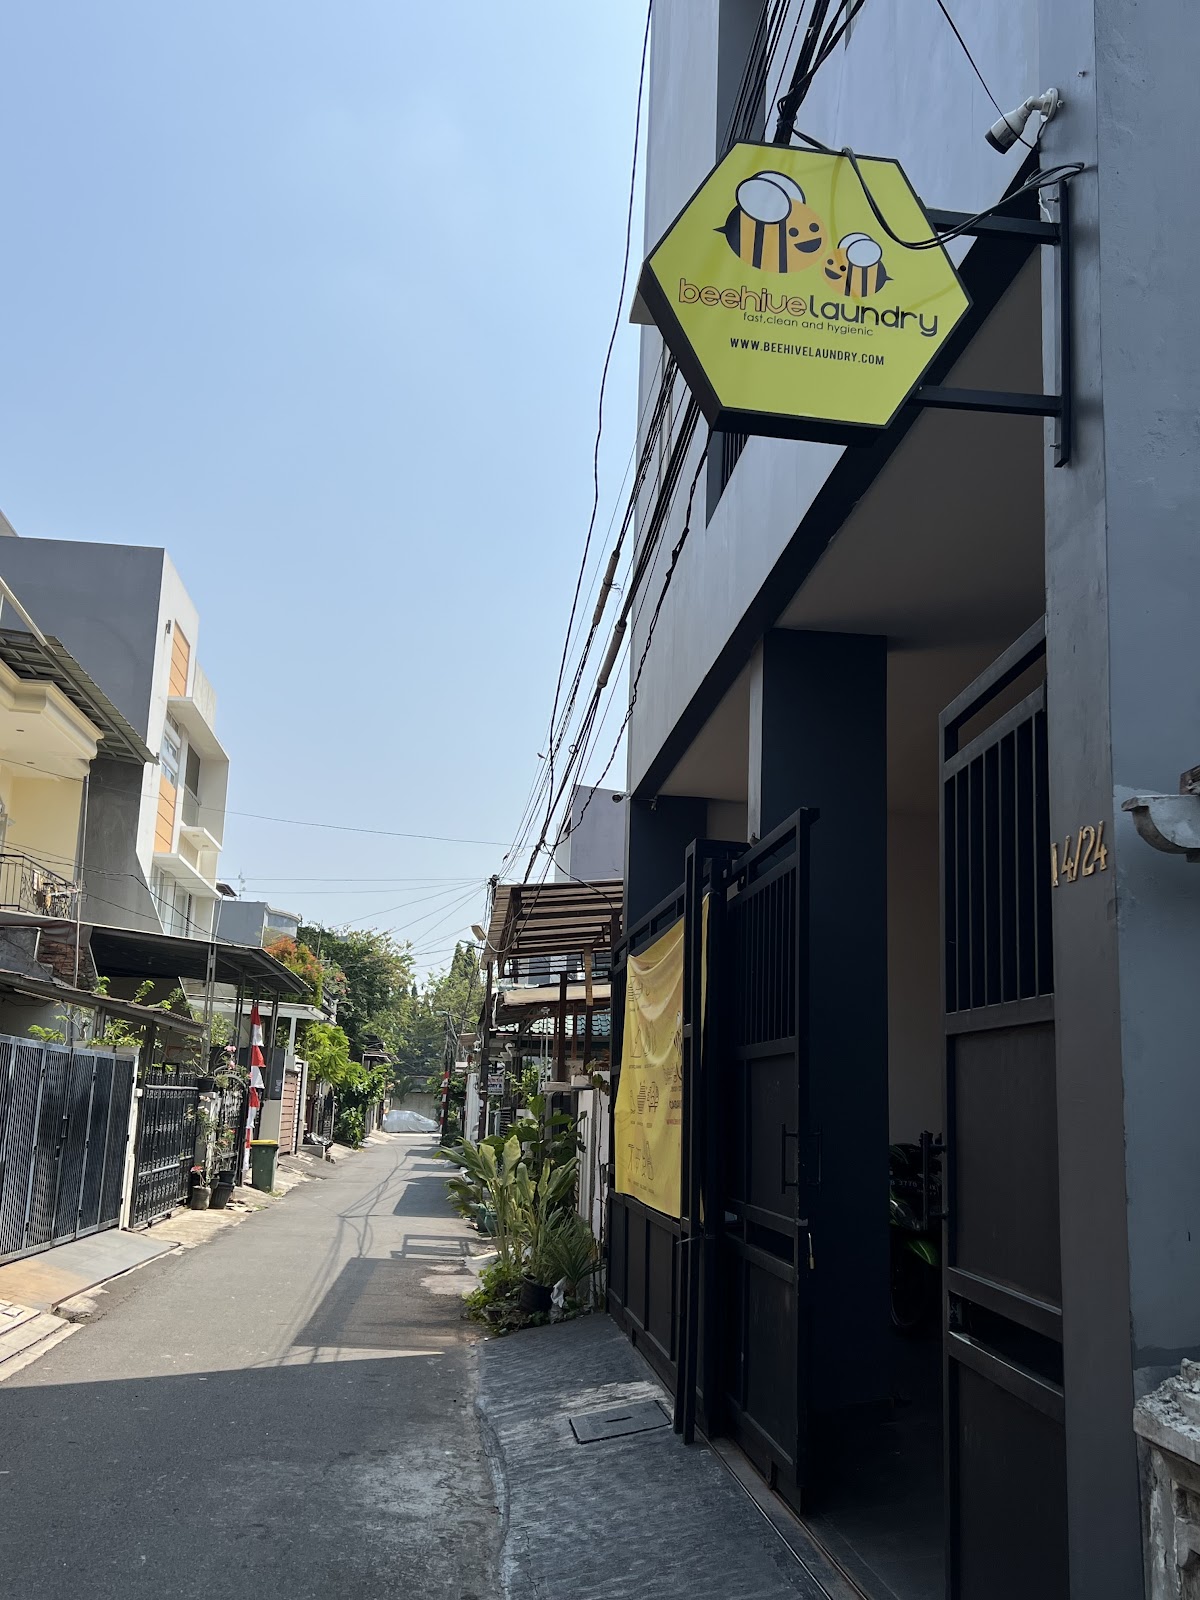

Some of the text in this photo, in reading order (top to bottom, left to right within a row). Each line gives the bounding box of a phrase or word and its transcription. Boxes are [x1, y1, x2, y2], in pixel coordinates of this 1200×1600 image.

[801, 318, 823, 331] and
[827, 322, 874, 336] hygienic
[730, 337, 884, 365] WWW.BEEHIVELAUNDRY.COM
[1050, 820, 1107, 887] 14/24
